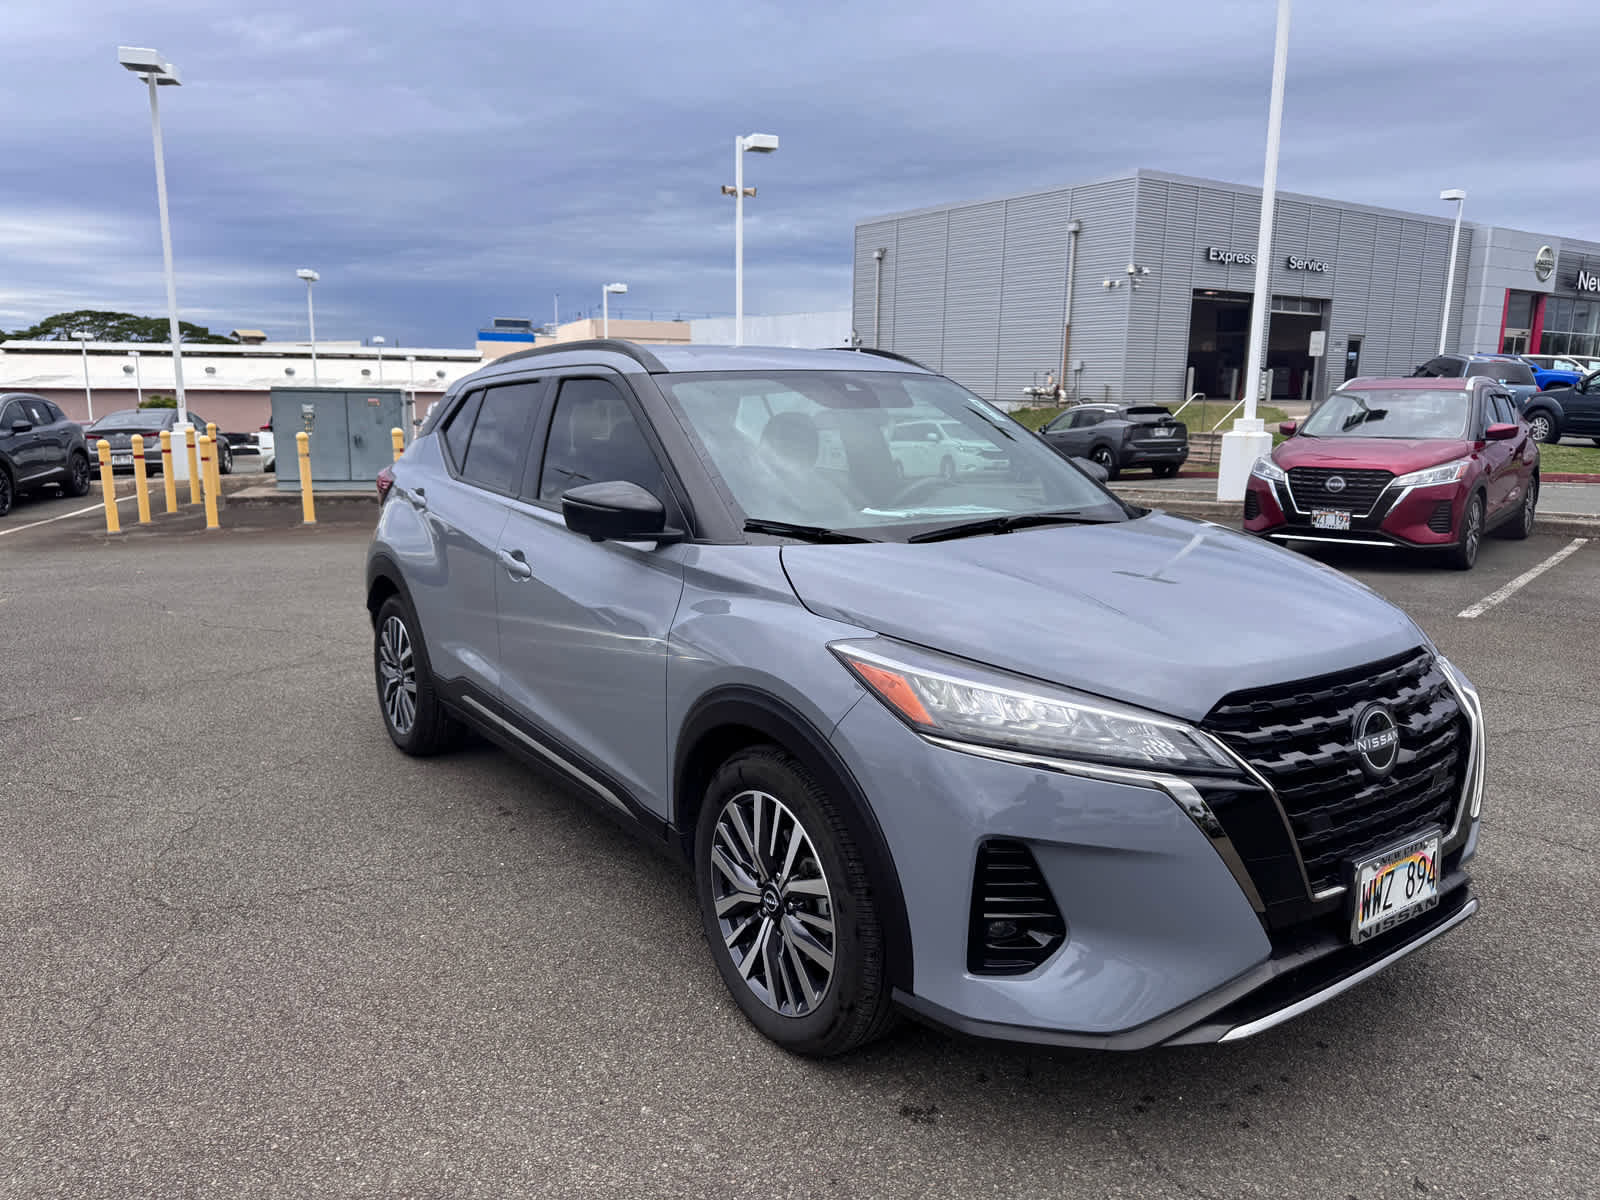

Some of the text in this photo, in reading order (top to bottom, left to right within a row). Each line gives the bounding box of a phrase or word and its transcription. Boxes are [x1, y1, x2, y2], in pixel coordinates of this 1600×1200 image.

[1209, 247, 1329, 272] Express Service
[1357, 729, 1399, 752] NISSAN
[1361, 850, 1436, 924] WWZ 894
[1358, 895, 1438, 943] NISSAN
